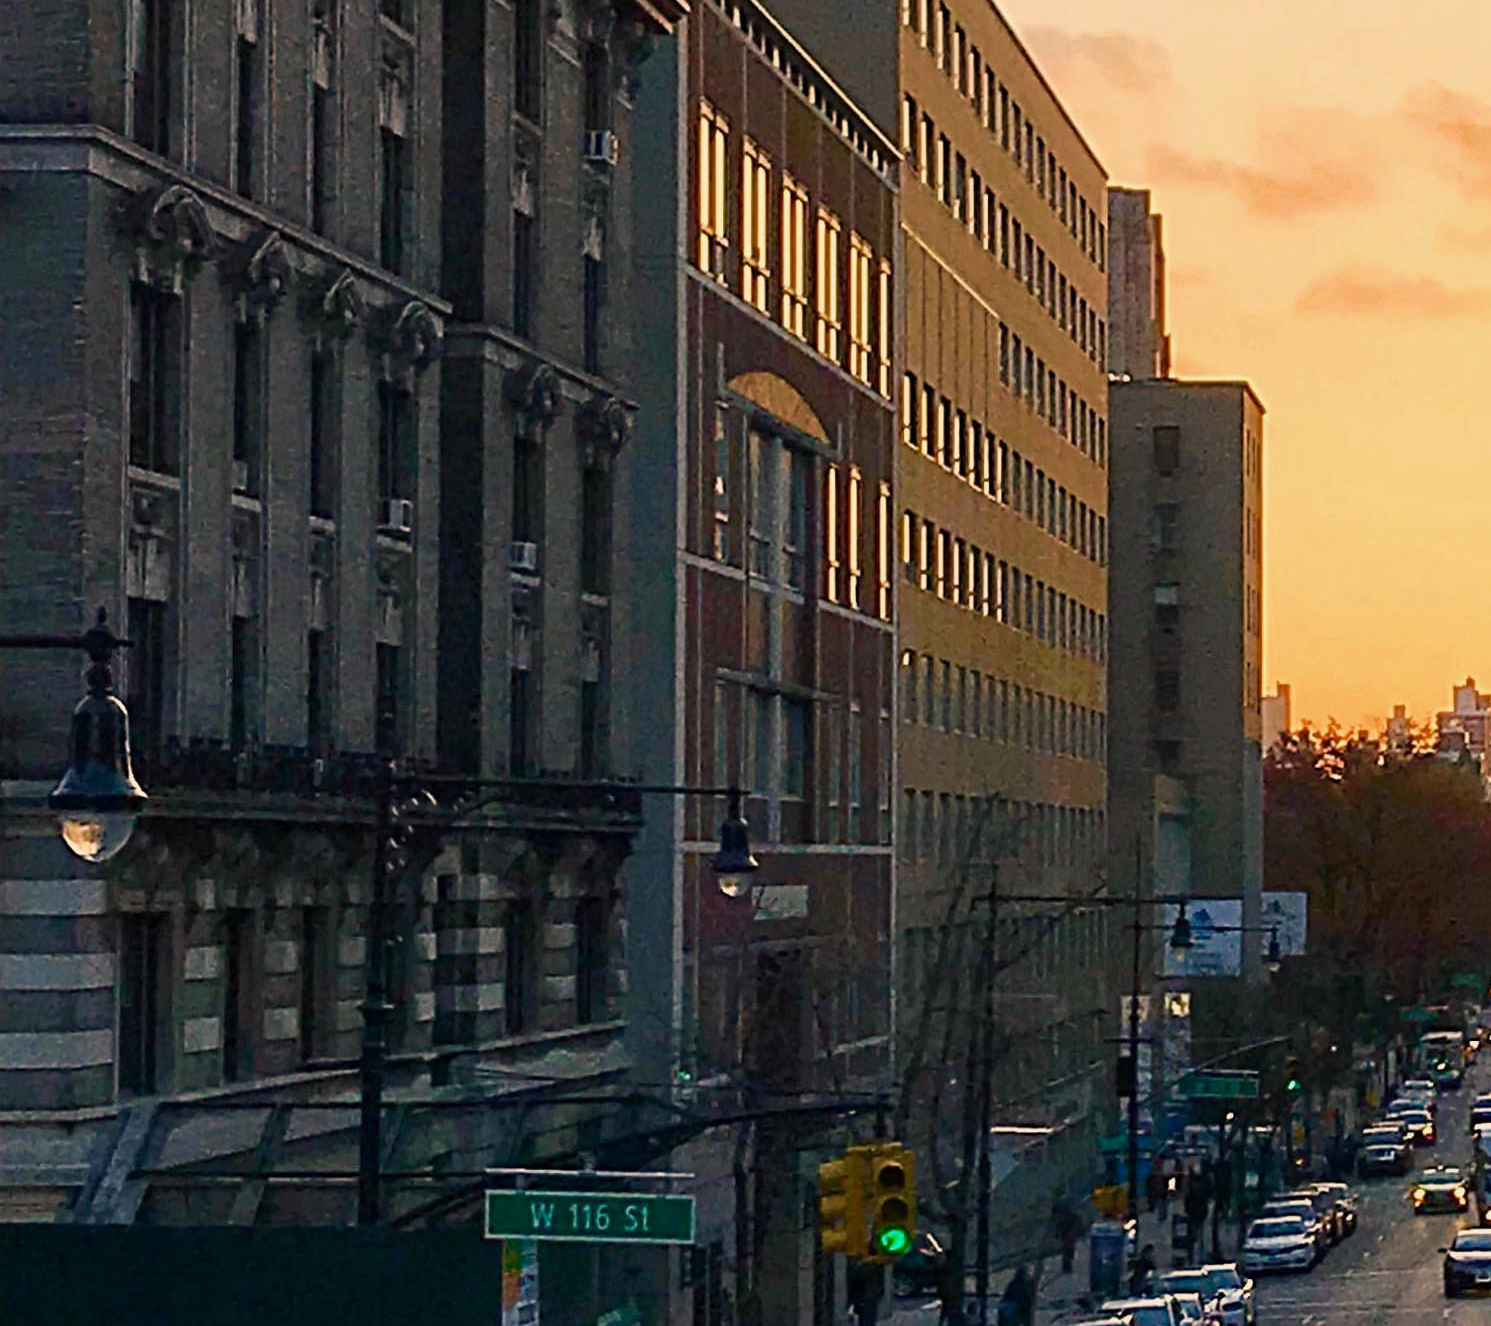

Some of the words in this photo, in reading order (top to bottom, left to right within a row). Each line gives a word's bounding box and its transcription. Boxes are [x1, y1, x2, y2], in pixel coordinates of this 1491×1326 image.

[530, 1203, 555, 1228] W
[569, 1203, 611, 1231] 116
[624, 1204, 649, 1232] St
